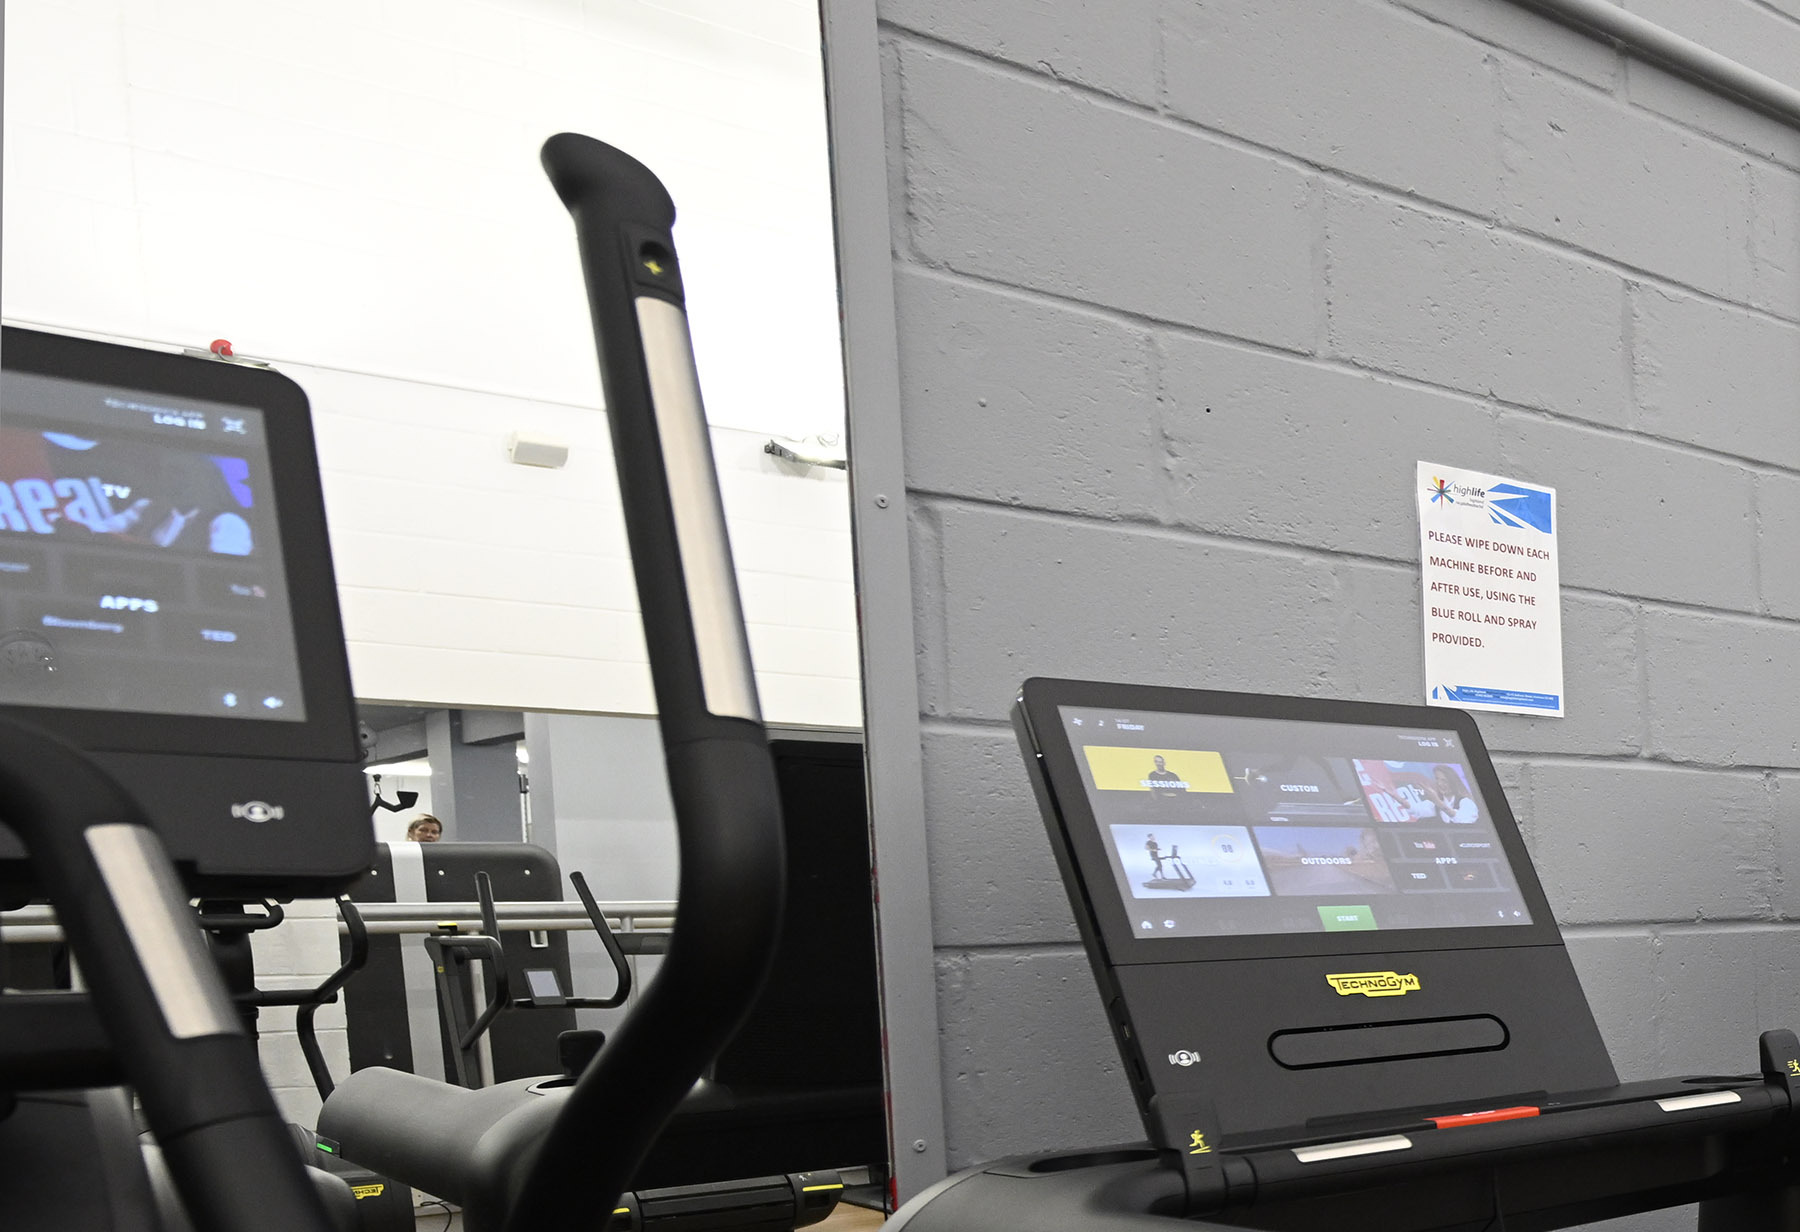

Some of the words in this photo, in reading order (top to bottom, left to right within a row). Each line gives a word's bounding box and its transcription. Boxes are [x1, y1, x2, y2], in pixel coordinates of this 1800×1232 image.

[101, 483, 131, 499] TV
[1453, 483, 1485, 498] highlife
[1428, 530, 1462, 546] PLEASE
[1464, 537, 1490, 551] WIPE
[1493, 541, 1524, 556] DOWN
[1526, 547, 1550, 561] EACH
[1429, 556, 1475, 573] MACHINE
[1477, 564, 1513, 579] BEFORE
[1516, 571, 1537, 582] AND
[1430, 581, 1460, 595] AFTER
[1462, 586, 1484, 600] USE,
[1486, 589, 1516, 604] USING
[1518, 594, 1536, 606] THE
[100, 595, 159, 613] APPS
[1431, 607, 1455, 619] BLUE
[1458, 611, 1482, 623] ROLL
[1484, 614, 1506, 626] AND
[1507, 617, 1537, 630] SPRAY
[1432, 632, 1485, 648] PROVIDED.
[1140, 779, 1191, 789] SESSIONS
[1280, 784, 1320, 793] CUSTOM
[1301, 857, 1353, 865] OUTDOORS
[1435, 857, 1458, 865] APPS
[1329, 974, 1416, 993] TECHNOGYM
